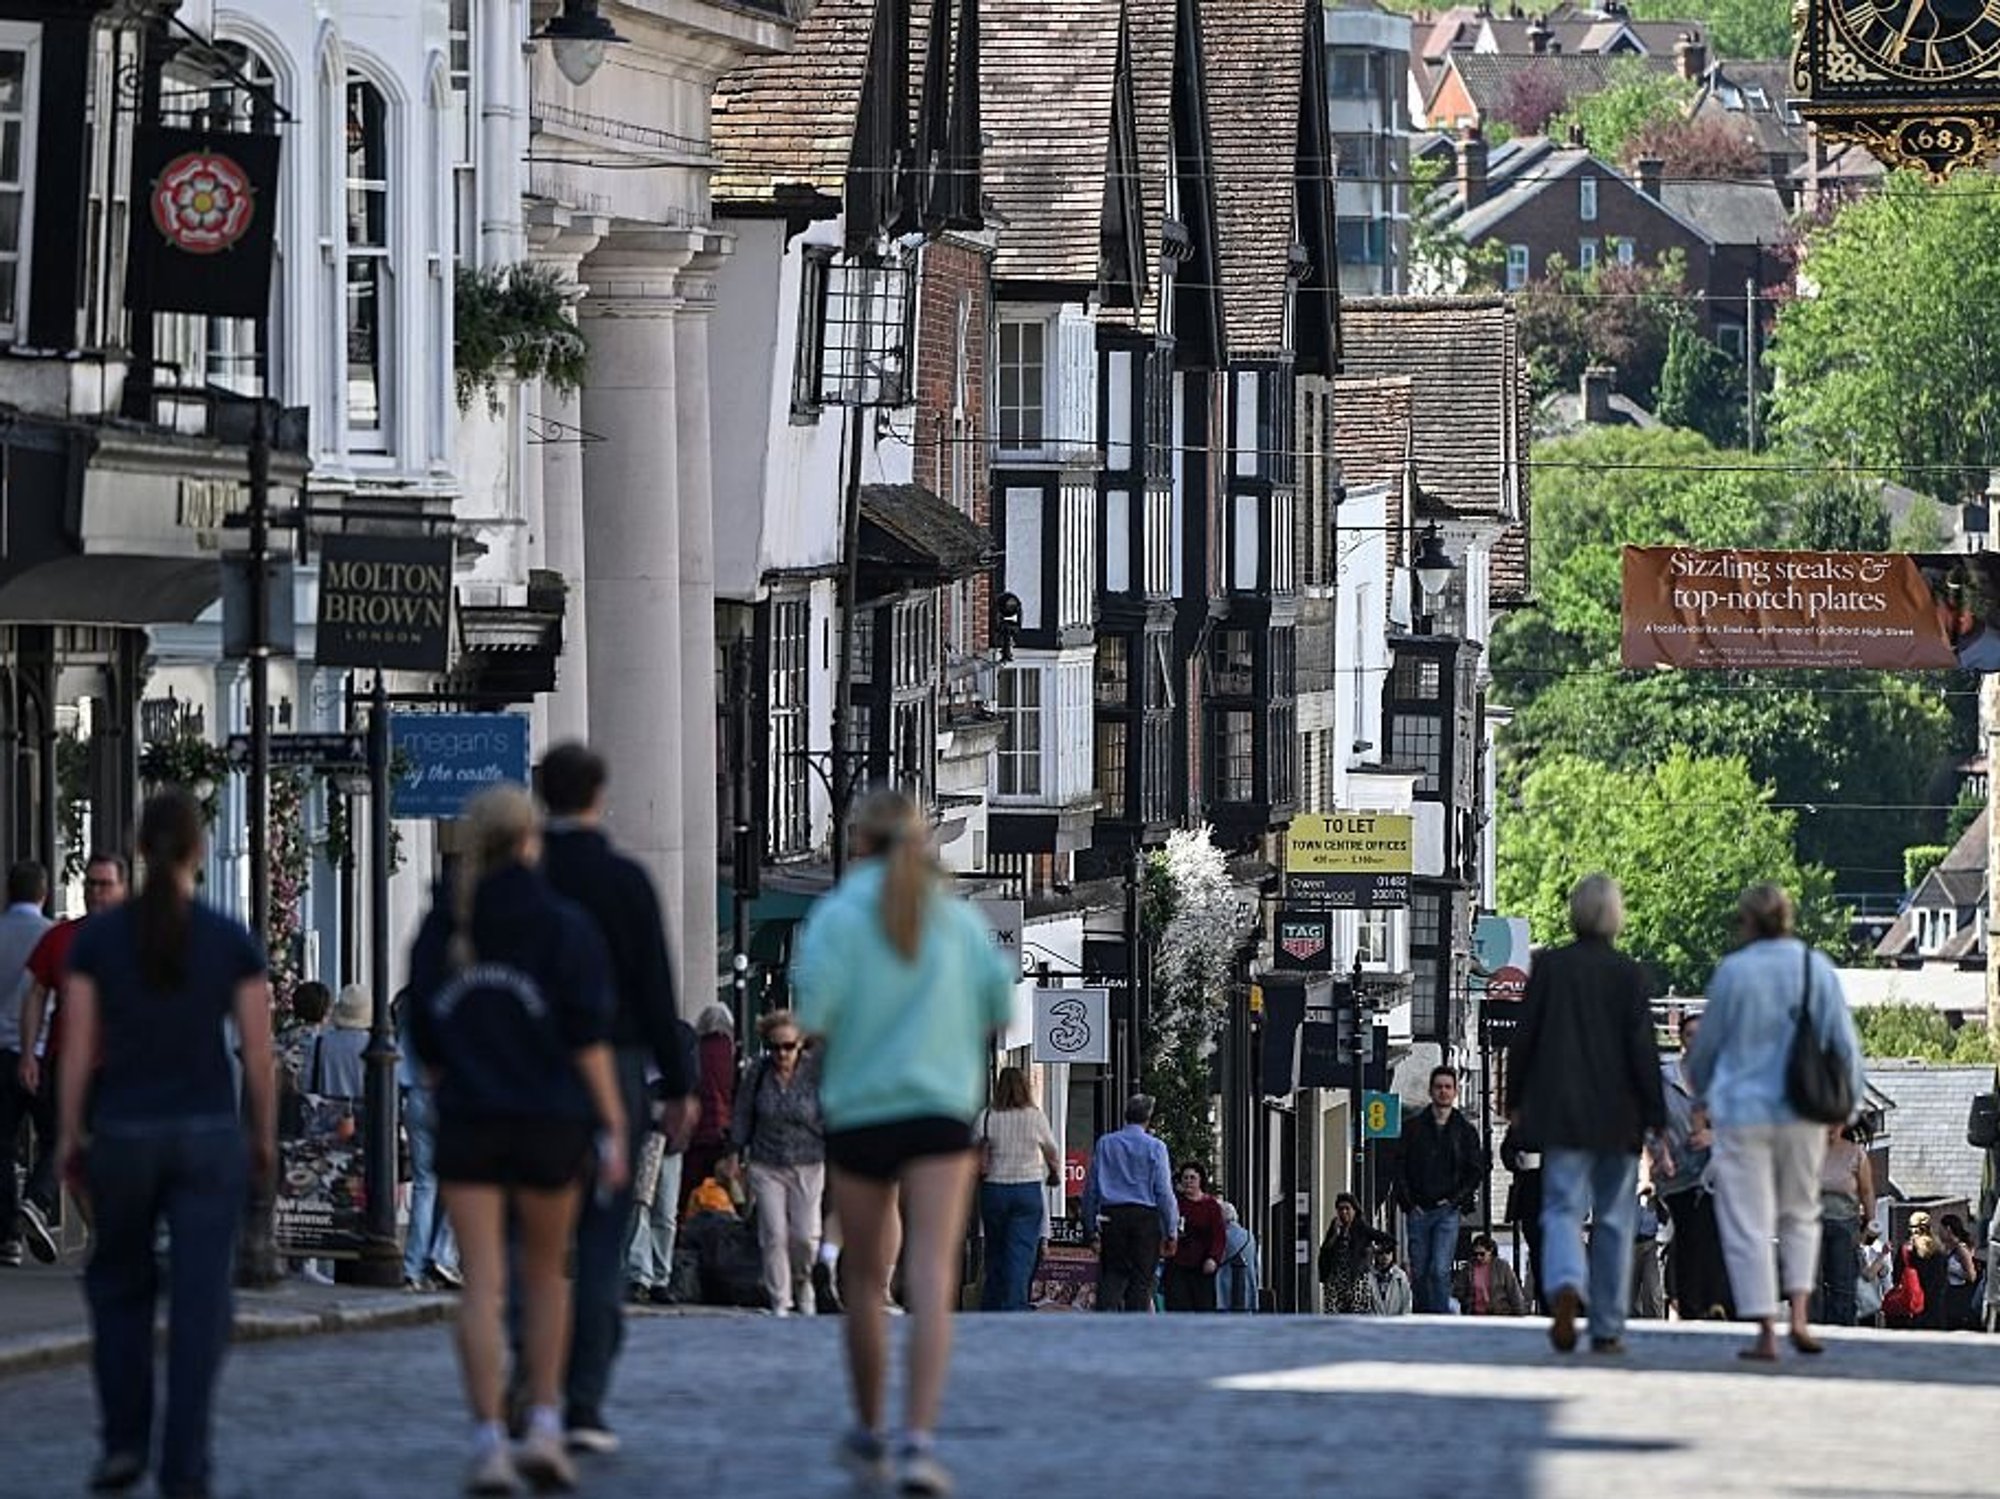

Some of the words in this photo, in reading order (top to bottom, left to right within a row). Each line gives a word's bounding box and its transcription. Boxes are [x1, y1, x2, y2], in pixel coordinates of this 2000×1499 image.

[1908, 128, 1964, 153] 1683
[326, 561, 446, 594] MOLTON
[1670, 553, 1771, 585] Sizzling
[1775, 556, 1854, 580] steaks
[1859, 557, 1892, 583] &
[325, 593, 446, 628] BROWN
[1674, 585, 1803, 615] top-notch
[1808, 586, 1887, 618] plates
[345, 631, 421, 643] LONDON
[1653, 624, 1676, 634] local
[1885, 628, 1914, 636] Street
[404, 729, 509, 759] megan's
[1322, 819, 1343, 833] TO
[1348, 819, 1375, 833] LET
[1292, 841, 1321, 851] TOWN
[1324, 841, 1364, 851] CENTRE
[1366, 840, 1407, 851] OFFICES
[1291, 878, 1325, 890] Owen
[1285, 926, 1321, 937] TAG
